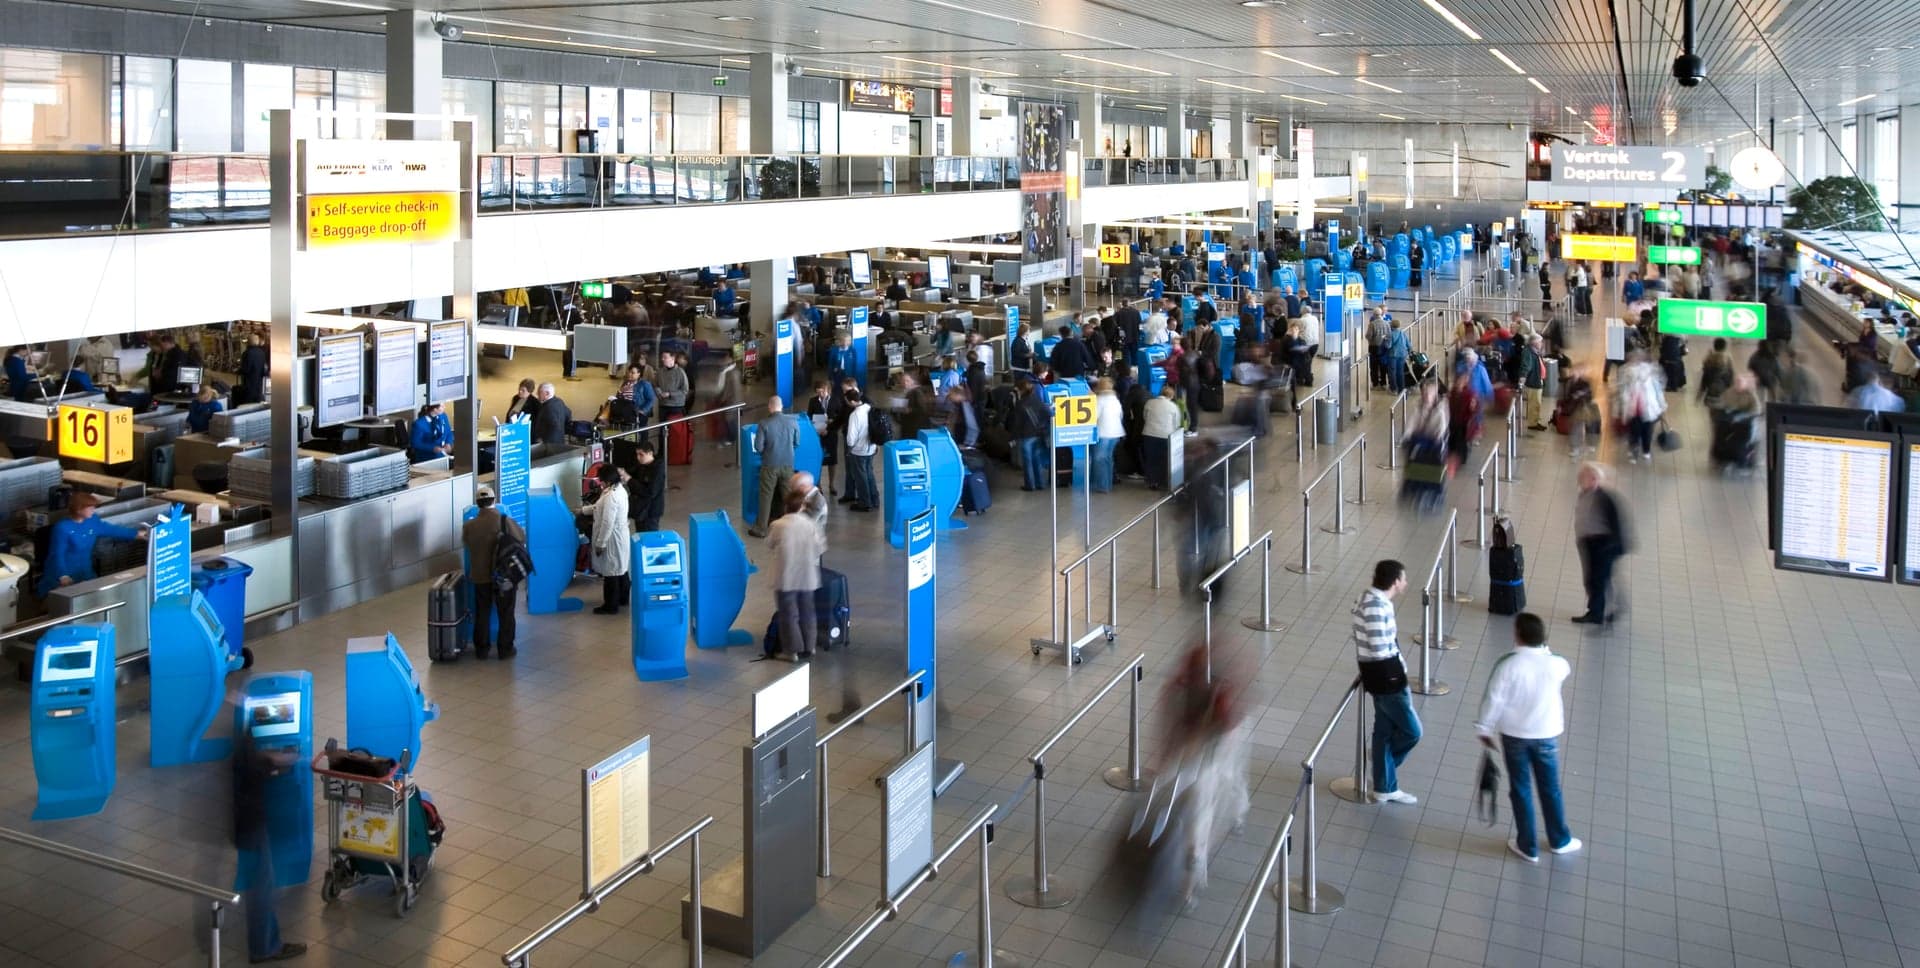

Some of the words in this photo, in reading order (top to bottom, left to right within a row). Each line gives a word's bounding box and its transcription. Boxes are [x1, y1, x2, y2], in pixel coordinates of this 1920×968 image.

[1563, 149, 1630, 164] Vertrek
[372, 164, 393, 172] KLM
[405, 162, 426, 171] nwa
[1660, 150, 1687, 182] 2
[1563, 166, 1656, 183] Departures
[324, 201, 391, 216] Self-service
[394, 200, 439, 213] check-in
[323, 223, 376, 239] Baggage
[380, 219, 427, 234] drop-off
[1105, 246, 1121, 258] 13
[1347, 285, 1362, 299] 14
[115, 414, 127, 424] 16
[1060, 398, 1092, 425] 15
[67, 411, 98, 447] 16
